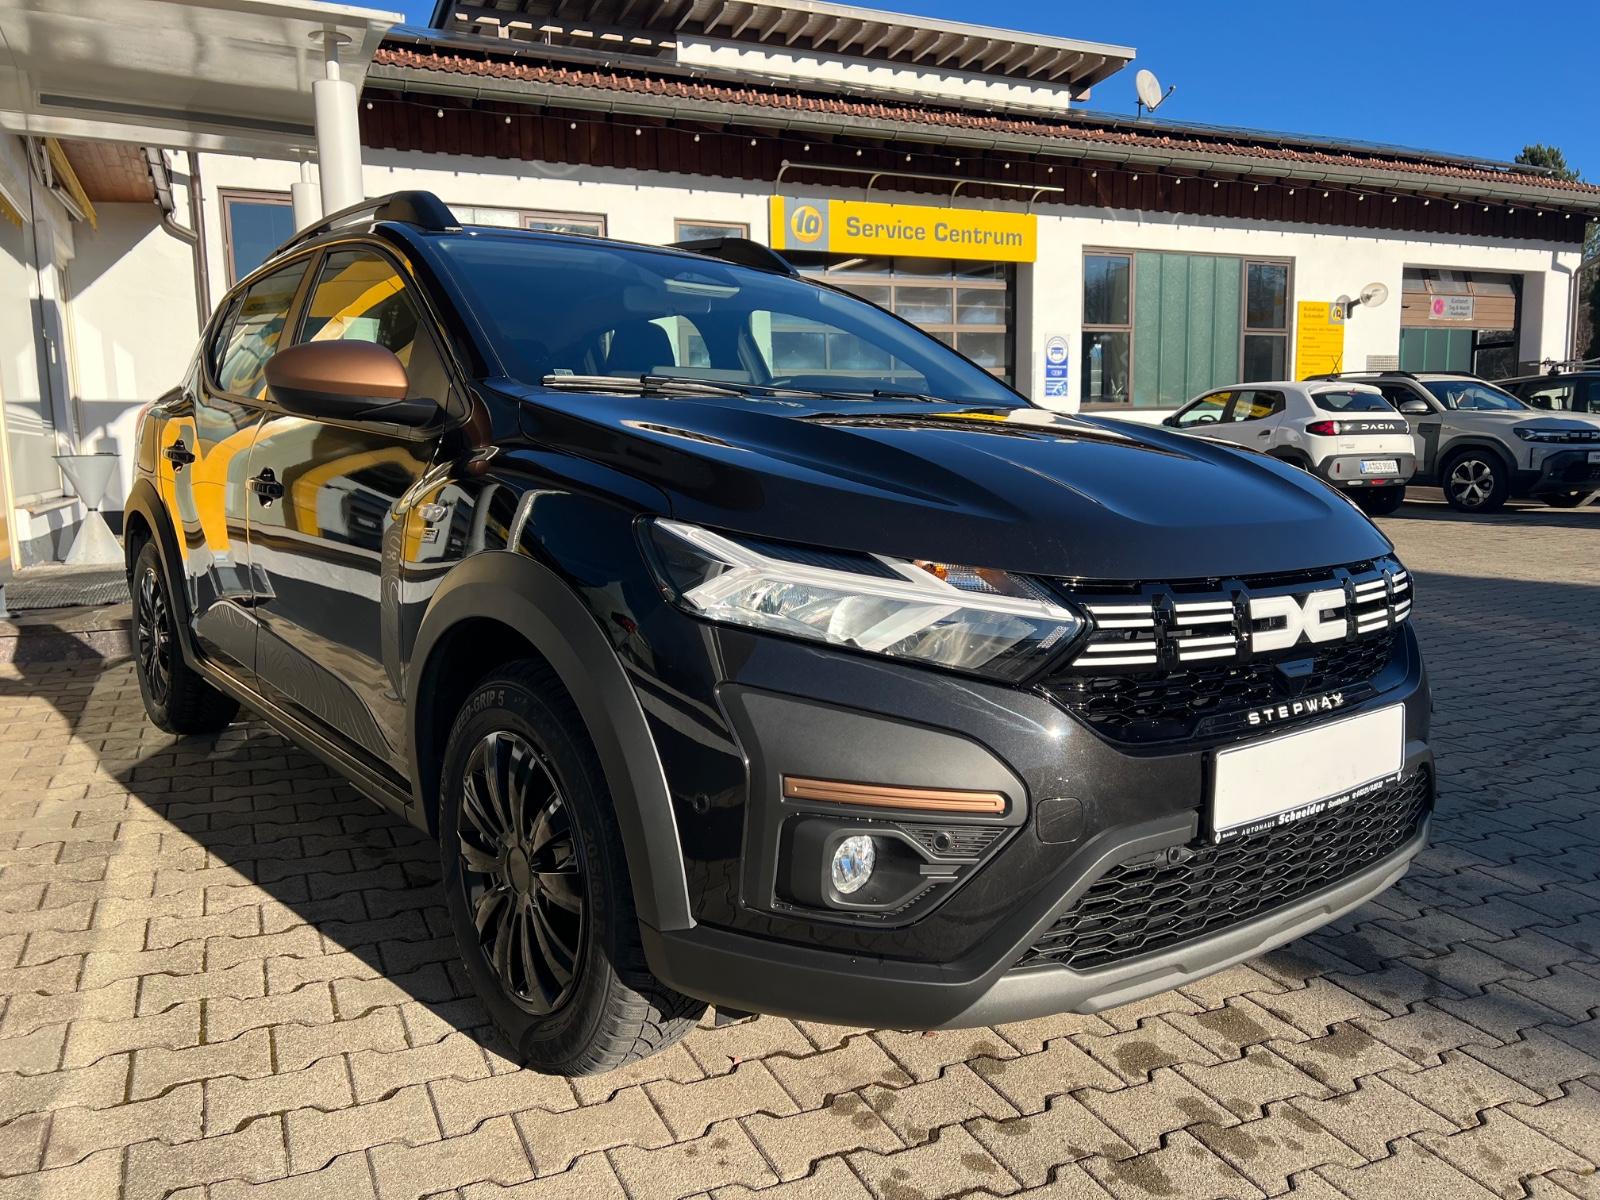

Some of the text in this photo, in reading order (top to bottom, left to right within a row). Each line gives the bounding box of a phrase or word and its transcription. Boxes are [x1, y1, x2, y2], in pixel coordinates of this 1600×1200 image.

[846, 216, 1023, 246] Service Centrum
[1248, 692, 1344, 725] STEPWAY
[1241, 821, 1275, 836] AUTOHAUS
[1278, 803, 1326, 825] Schneider
